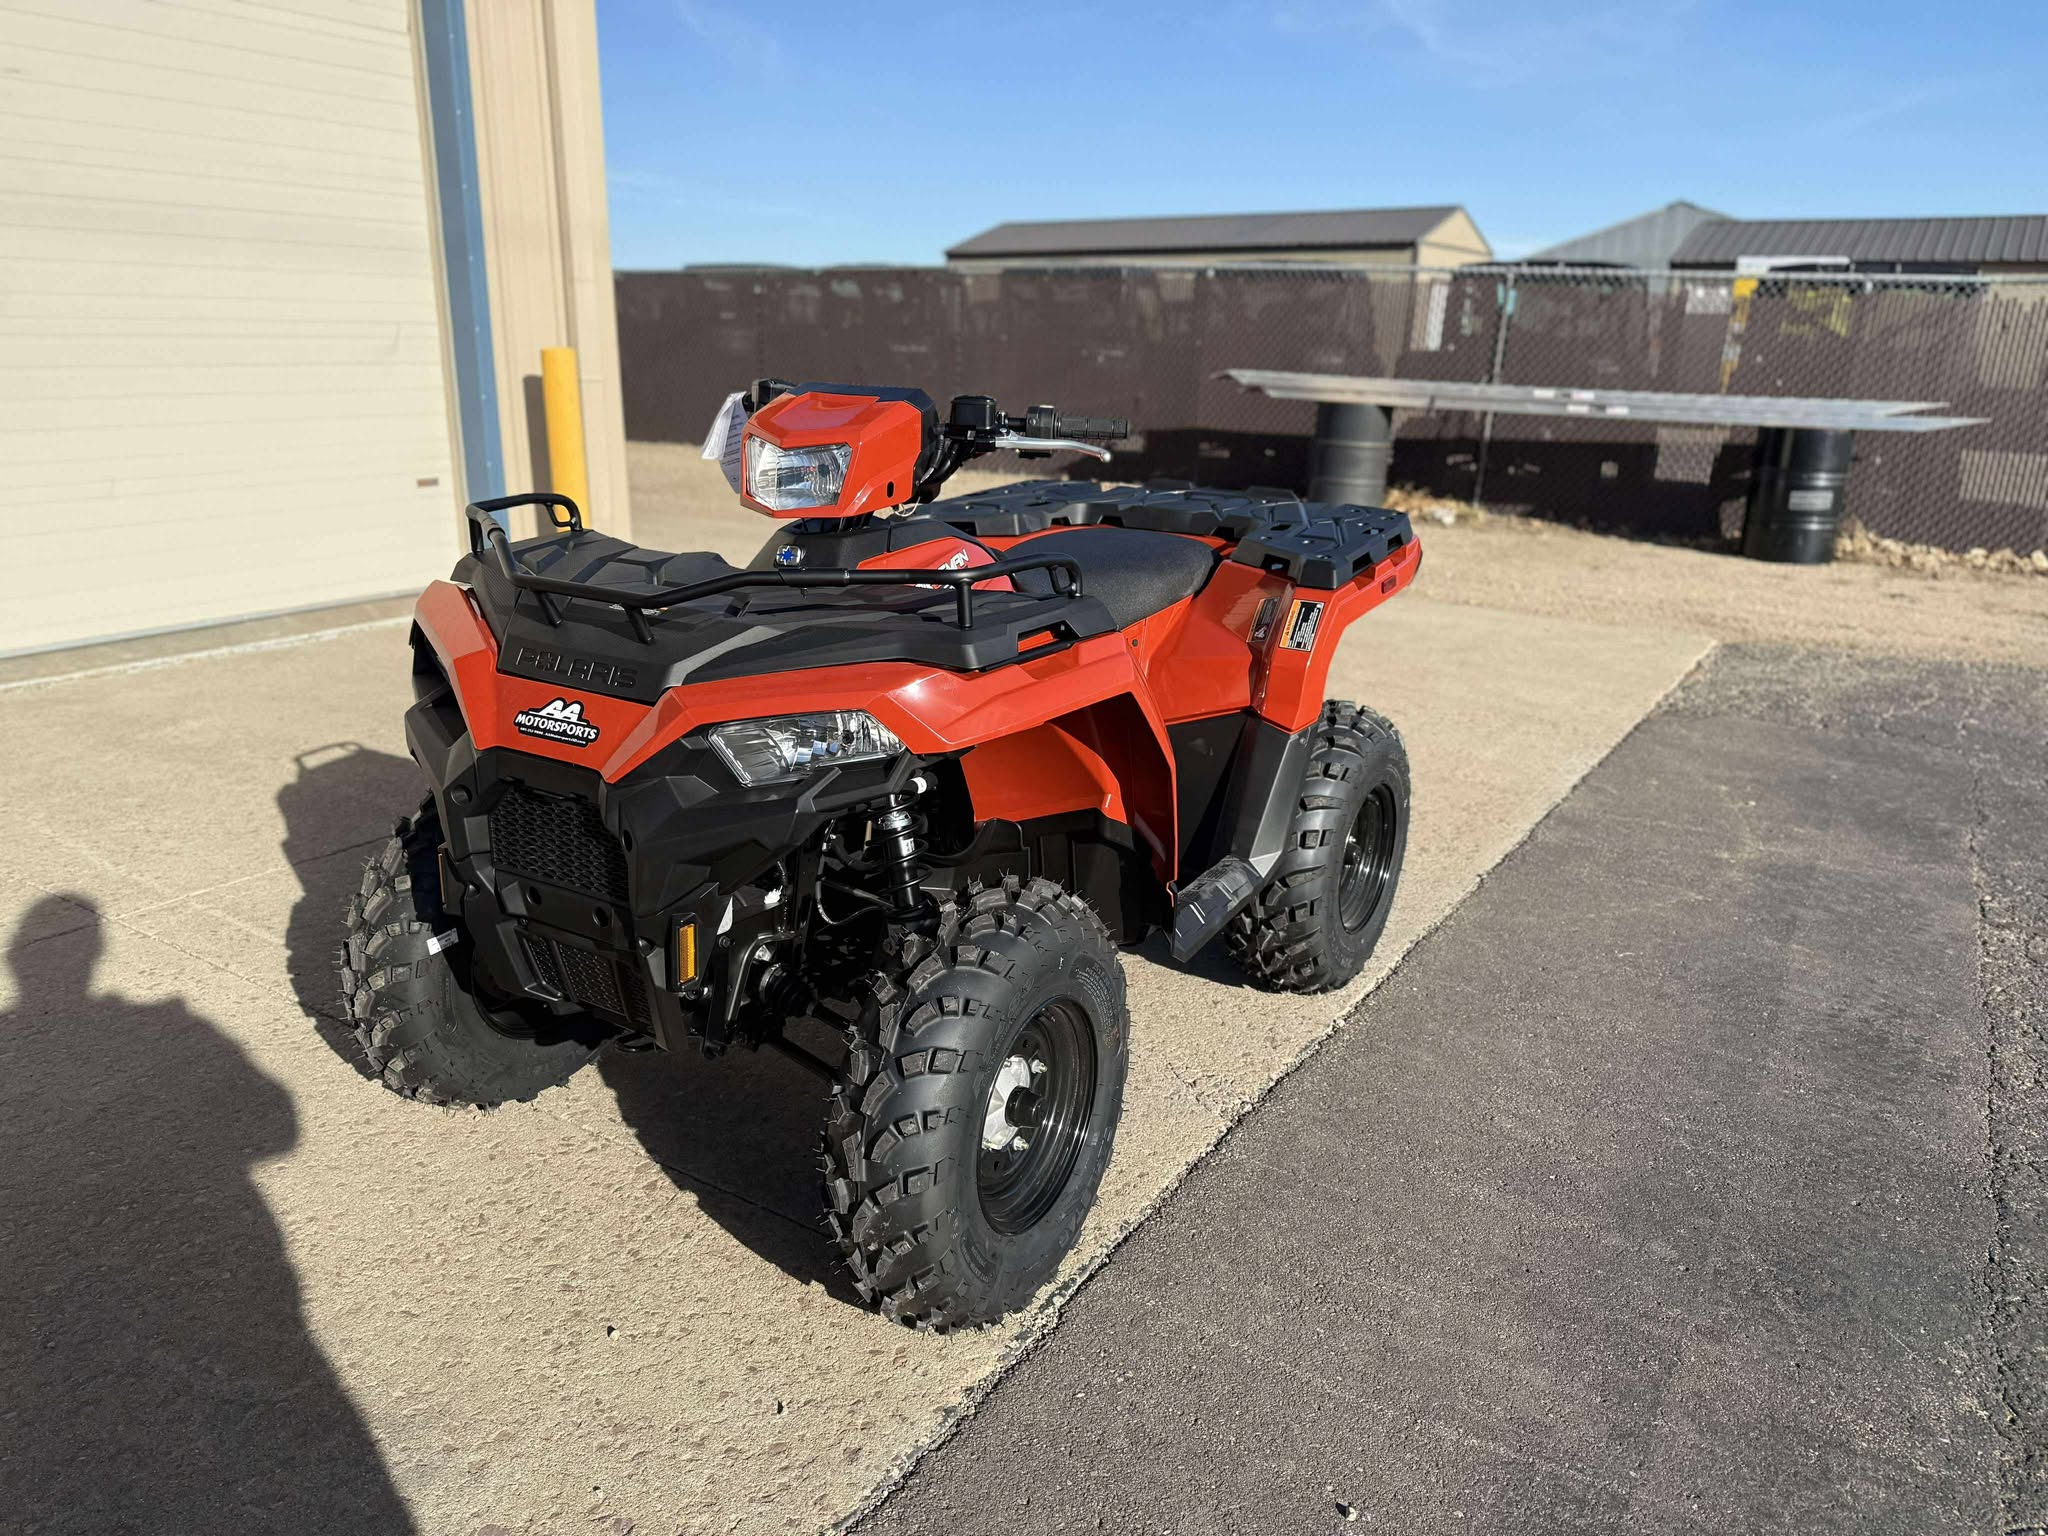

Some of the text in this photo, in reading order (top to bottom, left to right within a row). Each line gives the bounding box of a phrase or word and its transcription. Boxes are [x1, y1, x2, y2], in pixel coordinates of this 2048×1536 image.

[515, 647, 638, 688] POLARIS
[537, 699, 581, 721] AA
[515, 713, 598, 740] MOTORSPORTS
